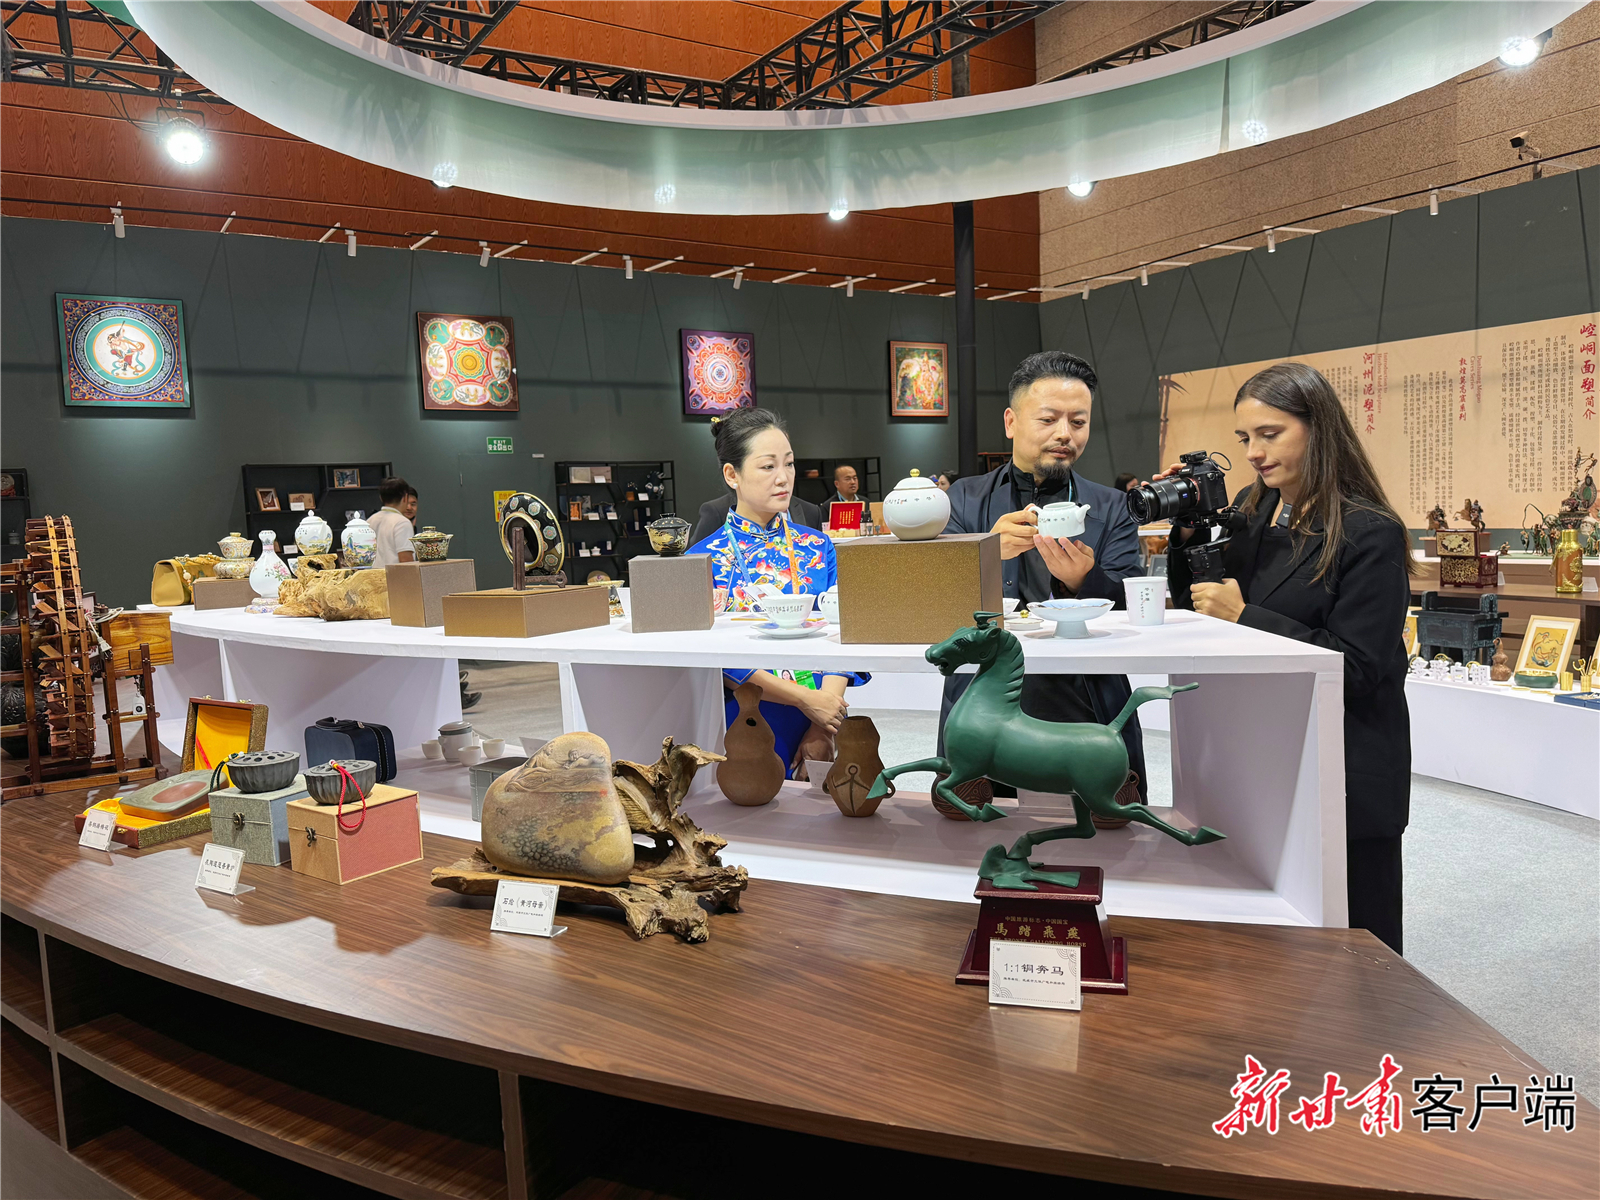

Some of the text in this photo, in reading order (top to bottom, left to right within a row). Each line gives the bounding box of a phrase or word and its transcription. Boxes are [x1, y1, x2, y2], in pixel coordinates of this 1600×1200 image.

[1363, 352, 1375, 434] 河州泥塑简介
[1580, 322, 1597, 420] 崆峒面塑简介
[1004, 963, 1064, 976] 1:1铜奔马
